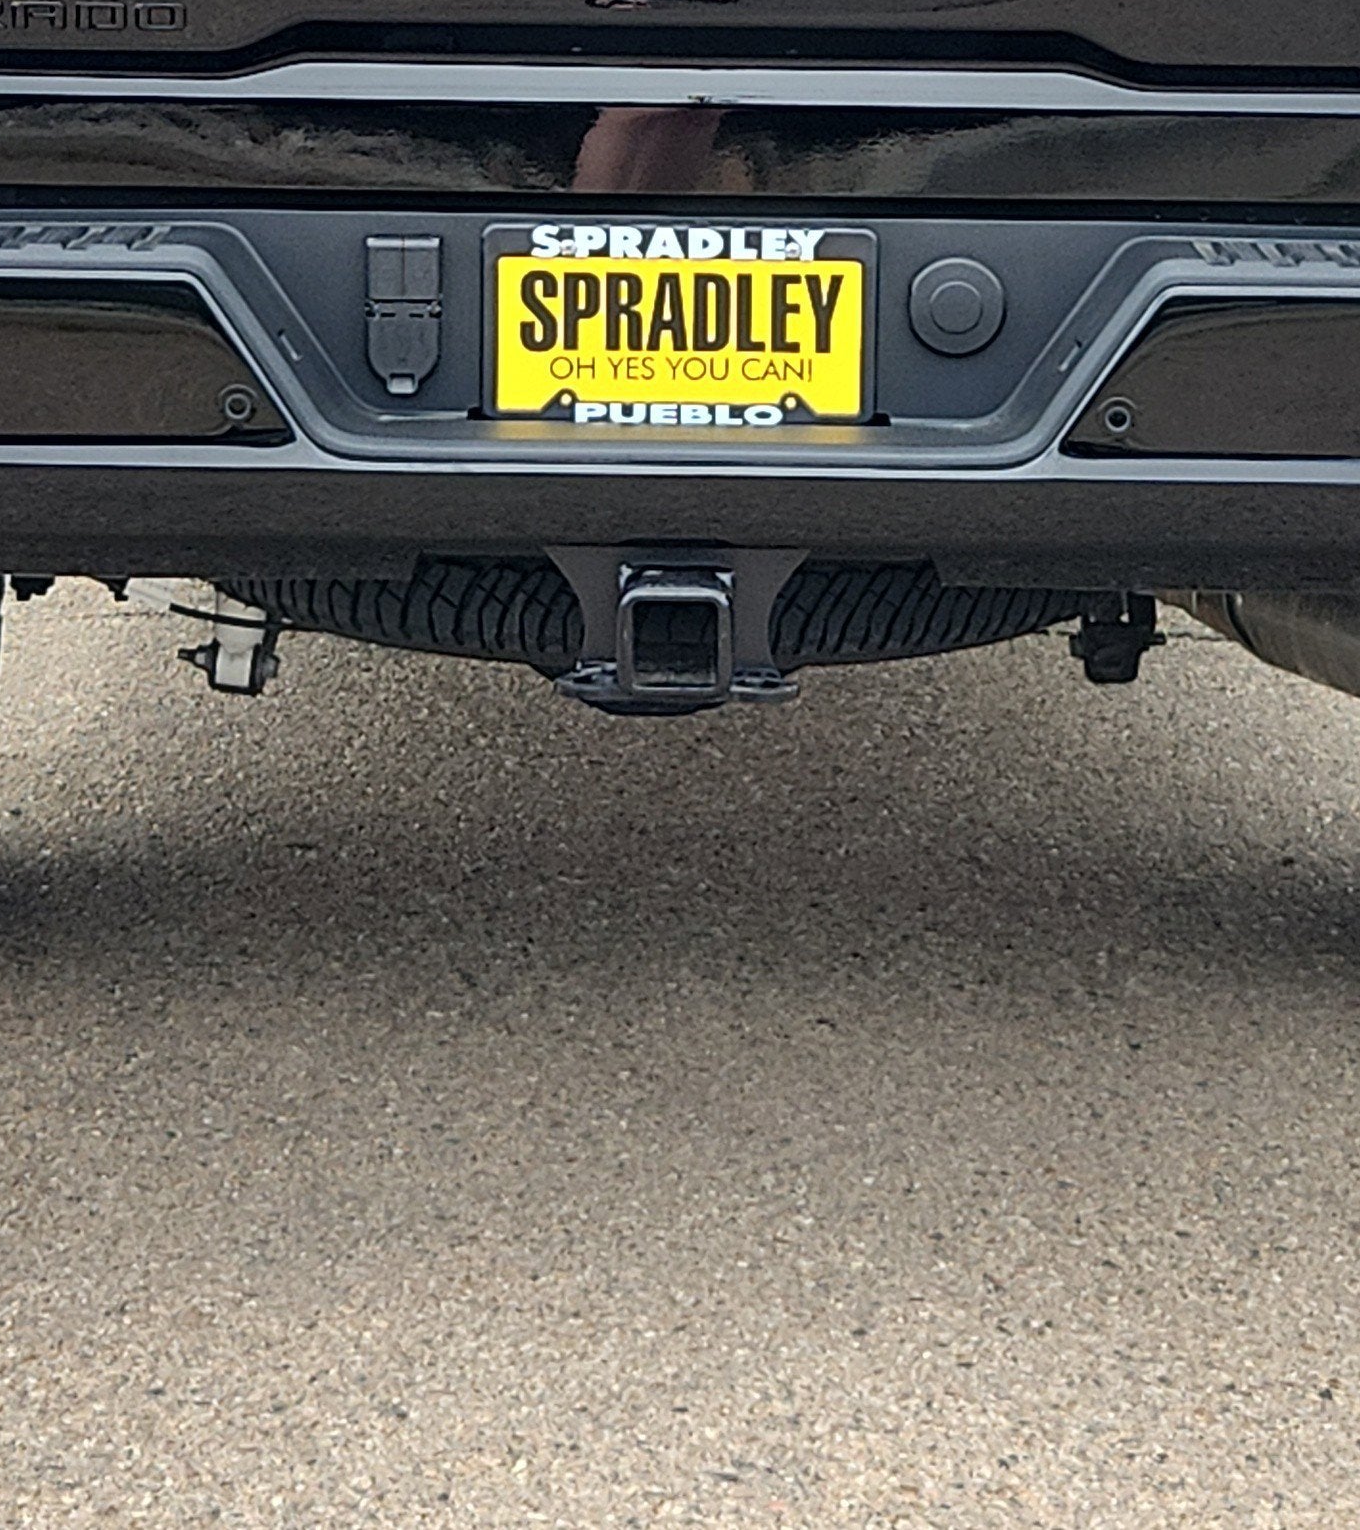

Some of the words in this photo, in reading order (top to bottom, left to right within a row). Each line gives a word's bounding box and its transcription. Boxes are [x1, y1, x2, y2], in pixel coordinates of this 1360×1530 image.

[530, 224, 826, 261] SPRADLEY
[520, 269, 844, 354] SPRADLEY
[550, 357, 596, 381] OH
[608, 357, 654, 381] YES
[666, 357, 729, 381] YOU
[741, 358, 812, 382] CAN!
[573, 402, 784, 426] PUEBLO
